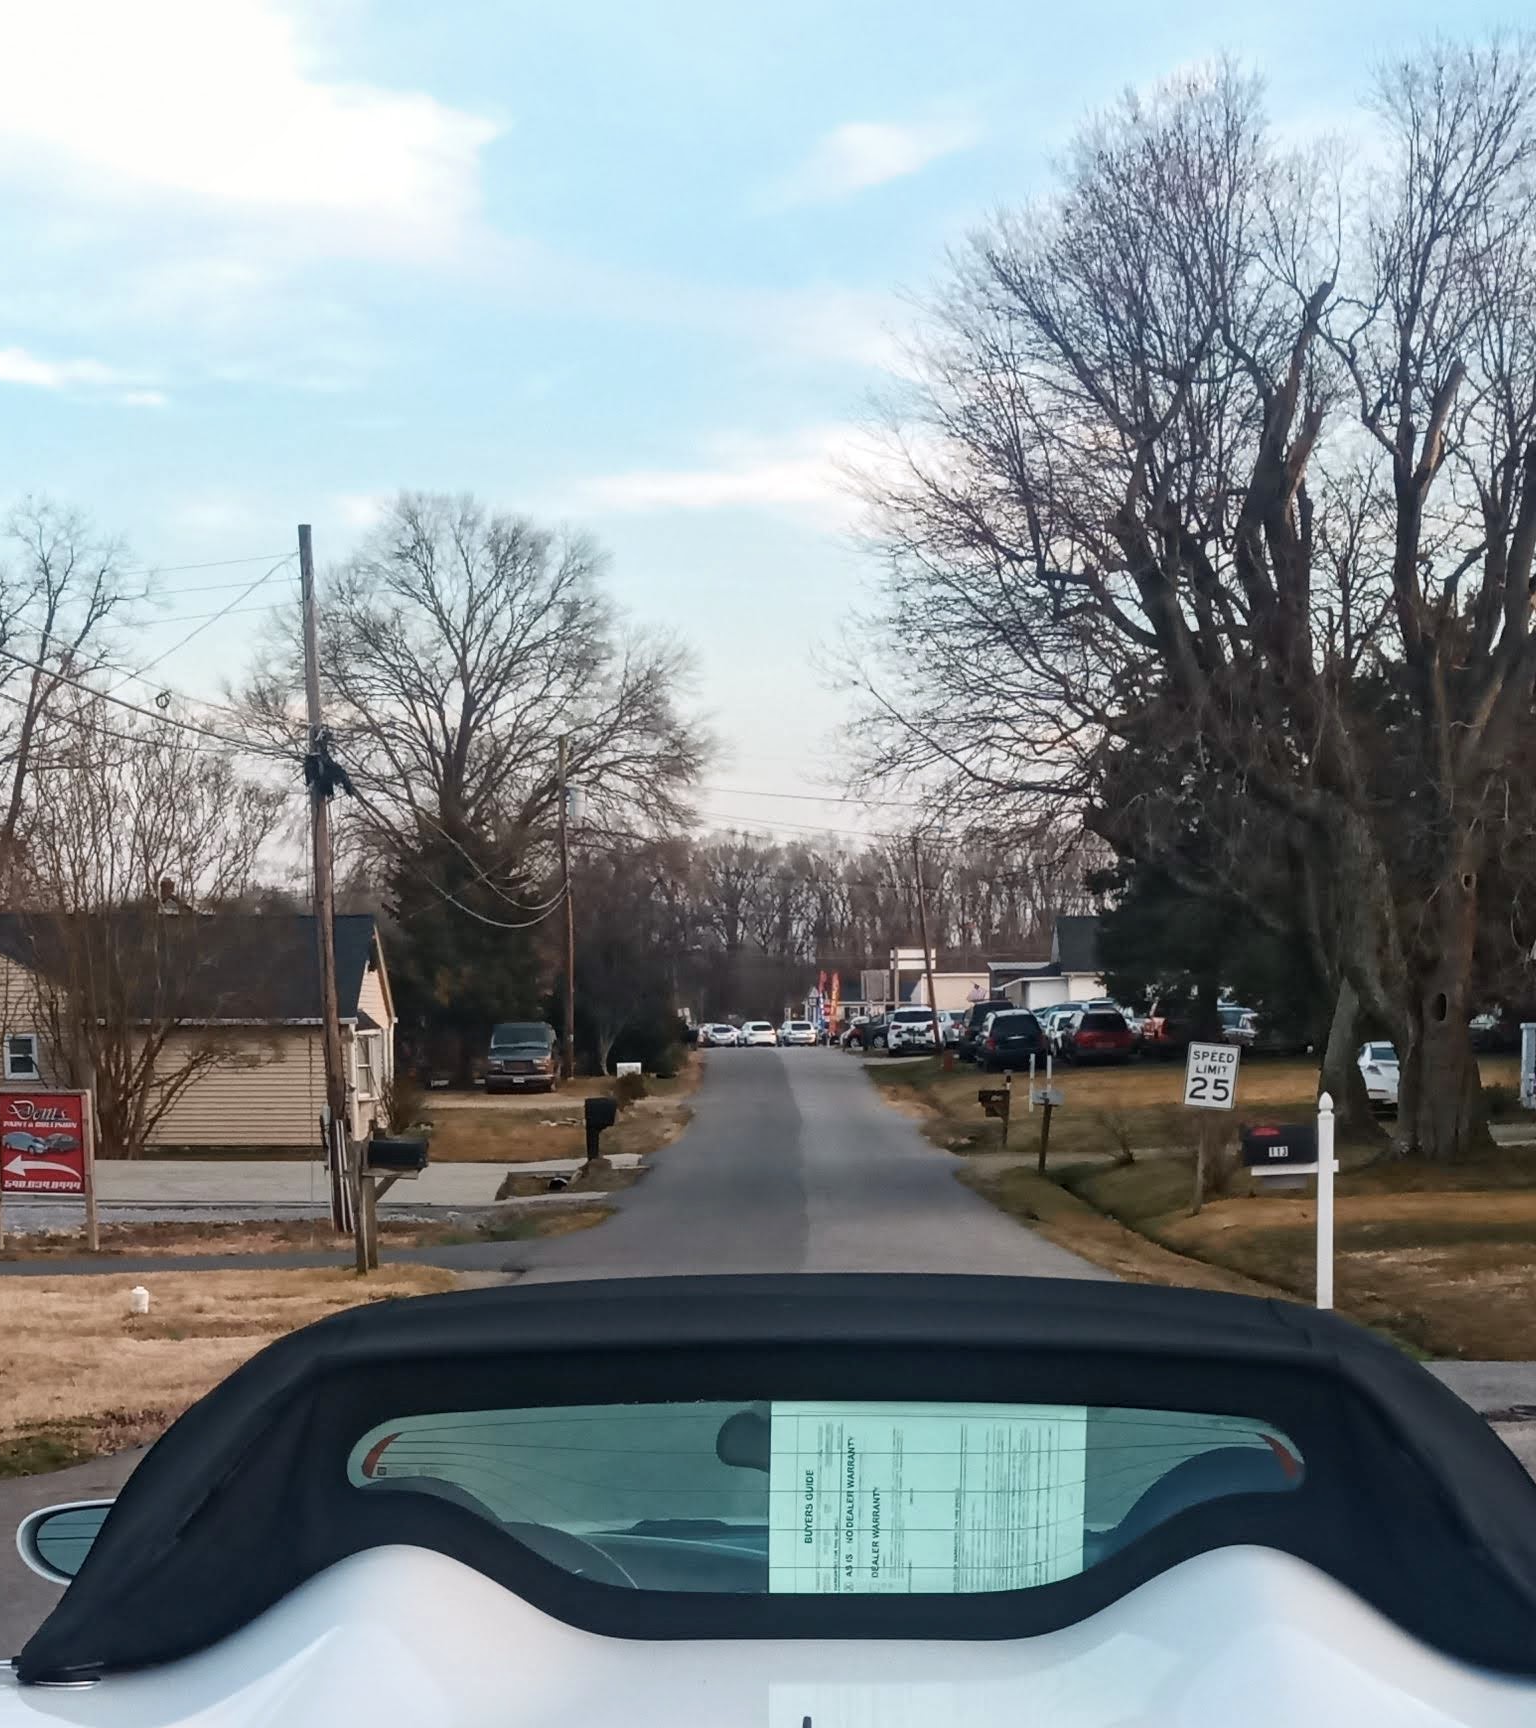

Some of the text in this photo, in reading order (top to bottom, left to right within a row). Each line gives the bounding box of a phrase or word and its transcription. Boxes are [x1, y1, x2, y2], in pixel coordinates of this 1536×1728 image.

[1192, 1050, 1235, 1064] SPEED
[1195, 1064, 1227, 1076] LIMIT
[1189, 1076, 1230, 1101] 25
[804, 1469, 814, 1544] BUYERS GUIDE
[846, 1436, 856, 1577] AS IS NO DEALER WARRANTY
[871, 1487, 881, 1578] DEALER WARRANTY
